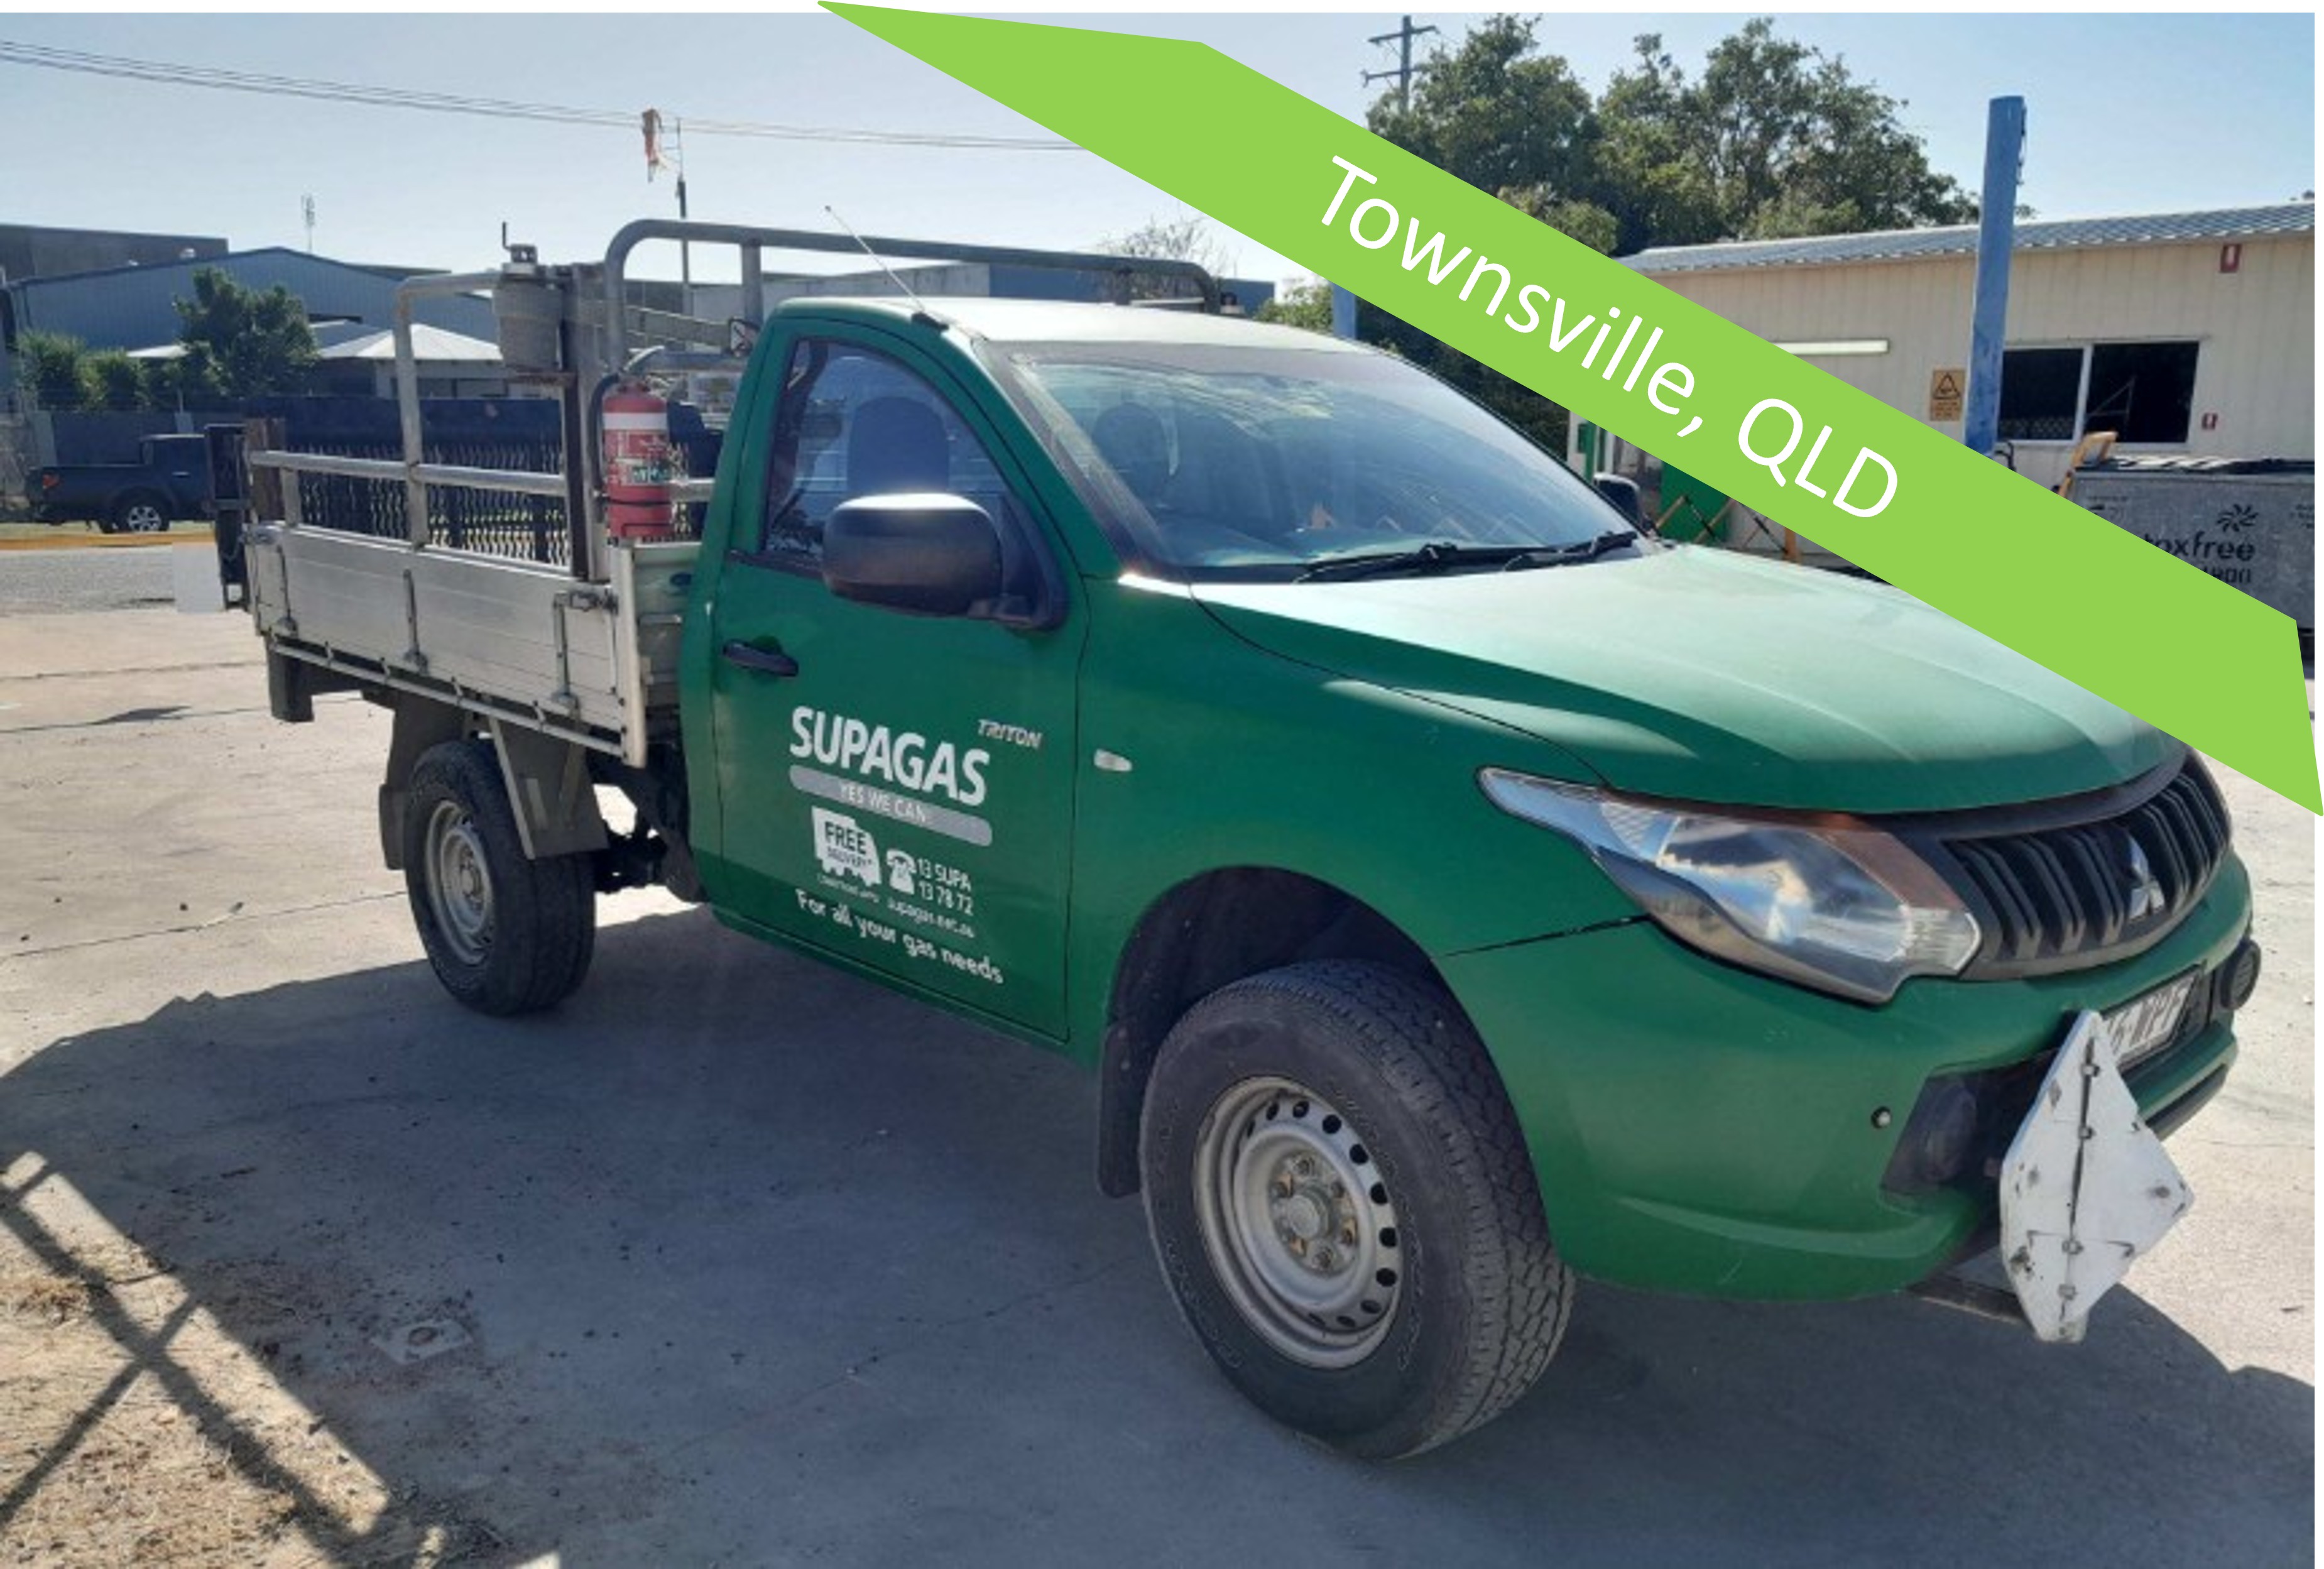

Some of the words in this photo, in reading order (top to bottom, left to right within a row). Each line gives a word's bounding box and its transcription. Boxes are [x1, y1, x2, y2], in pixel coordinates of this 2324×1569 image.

[978, 719, 1043, 748] TRITON
[789, 706, 990, 806] SUPAGAS
[841, 784, 864, 804] YES
[867, 790, 890, 811] WE
[894, 797, 927, 823] CAN
[824, 821, 867, 855] FREE
[917, 858, 932, 878] 13
[934, 863, 972, 892] SUPA
[918, 881, 933, 901] 13
[937, 885, 954, 909] 78
[956, 894, 973, 916] 72
[795, 888, 826, 916] For
[831, 902, 853, 927] all
[855, 916, 897, 943] your
[903, 934, 937, 959] gas
[941, 948, 1004, 984] needs
